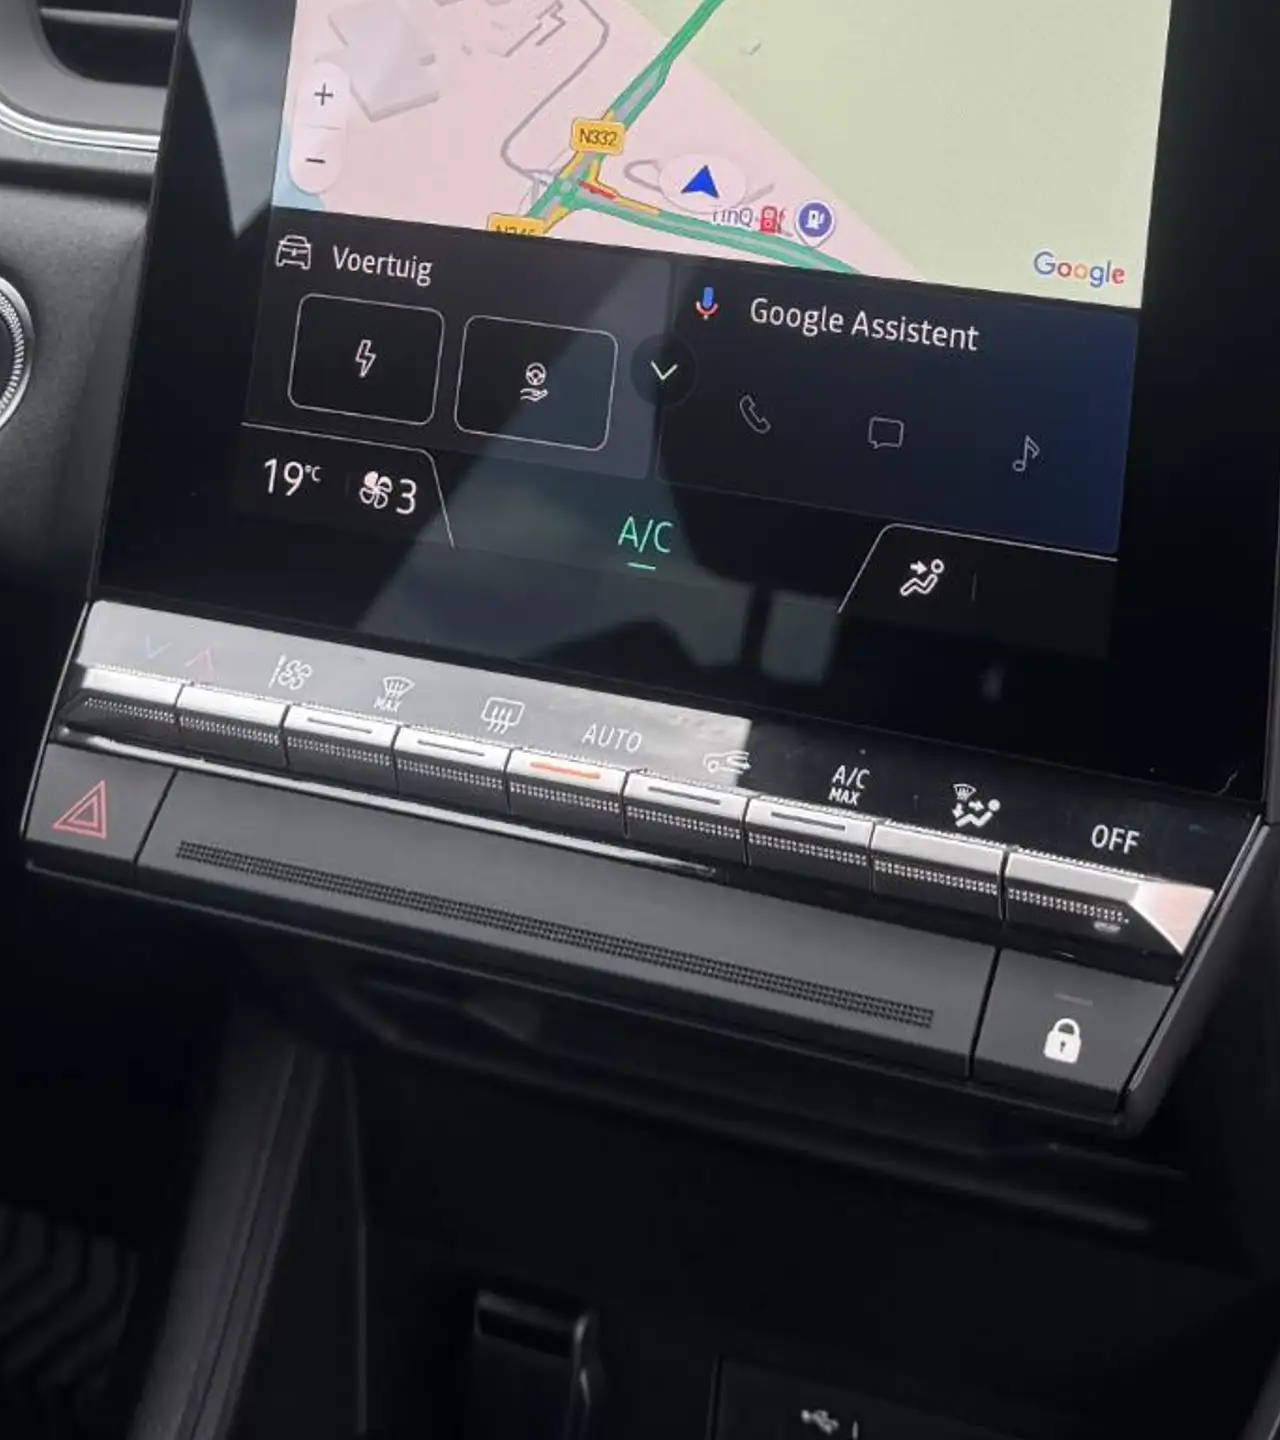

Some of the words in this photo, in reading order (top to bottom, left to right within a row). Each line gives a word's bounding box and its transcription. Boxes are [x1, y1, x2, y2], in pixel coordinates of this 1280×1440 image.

[579, 127, 618, 147] N332
[332, 245, 433, 287] Voertuig
[1032, 251, 1126, 288] Google
[749, 297, 844, 337] Google
[851, 310, 980, 351] Assistent
[396, 479, 419, 515] 3
[618, 515, 674, 554] A/C
[373, 692, 402, 711] MAX
[582, 722, 644, 752] AUTO
[830, 764, 870, 790] A/C
[828, 786, 861, 807] MAX
[1090, 824, 1140, 855] OFF
